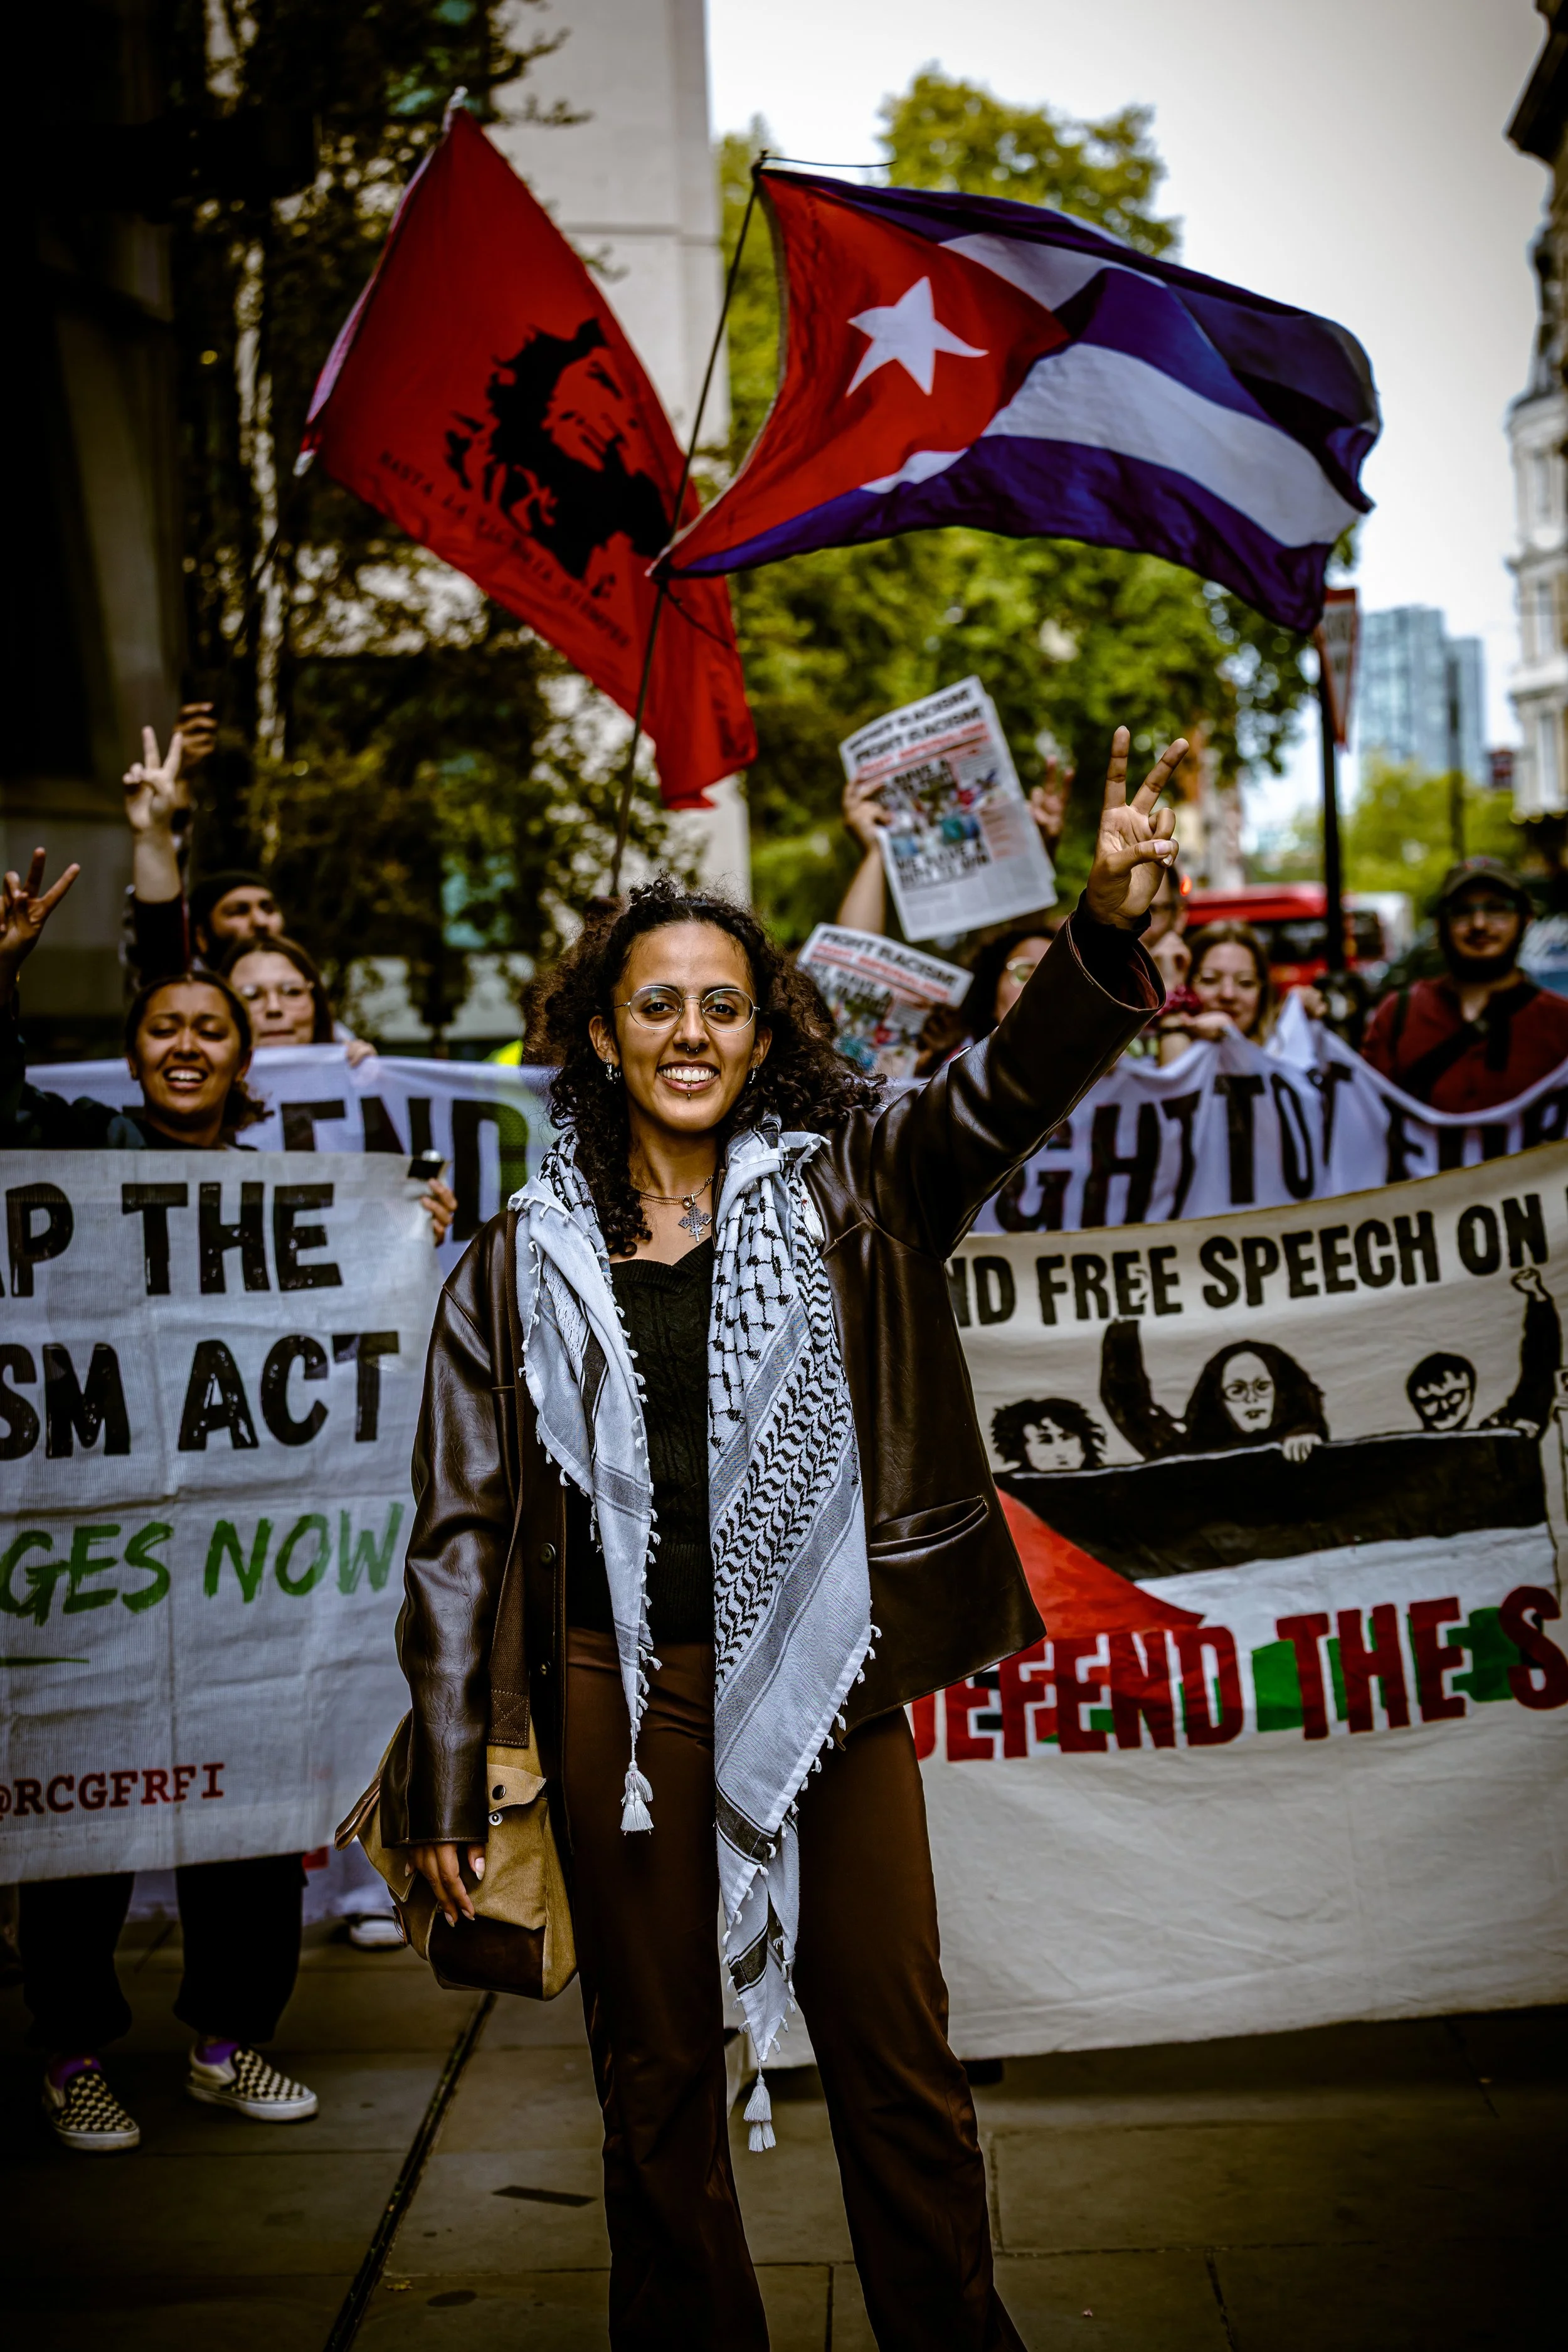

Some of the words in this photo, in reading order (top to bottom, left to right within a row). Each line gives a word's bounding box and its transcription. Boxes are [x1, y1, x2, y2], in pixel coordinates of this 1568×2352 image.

[0, 1182, 73, 1298] P
[122, 1182, 343, 1296] THE
[1036, 1246, 1183, 1325] FREE
[1199, 1210, 1441, 1309] SPEECH
[1457, 1194, 1549, 1276] ON
[177, 1331, 400, 1451] ACT
[0, 1520, 173, 1627] GES
[203, 1502, 405, 1603] NOW
[911, 1626, 1244, 1763] EFEND
[1276, 1595, 1467, 1740] THE
